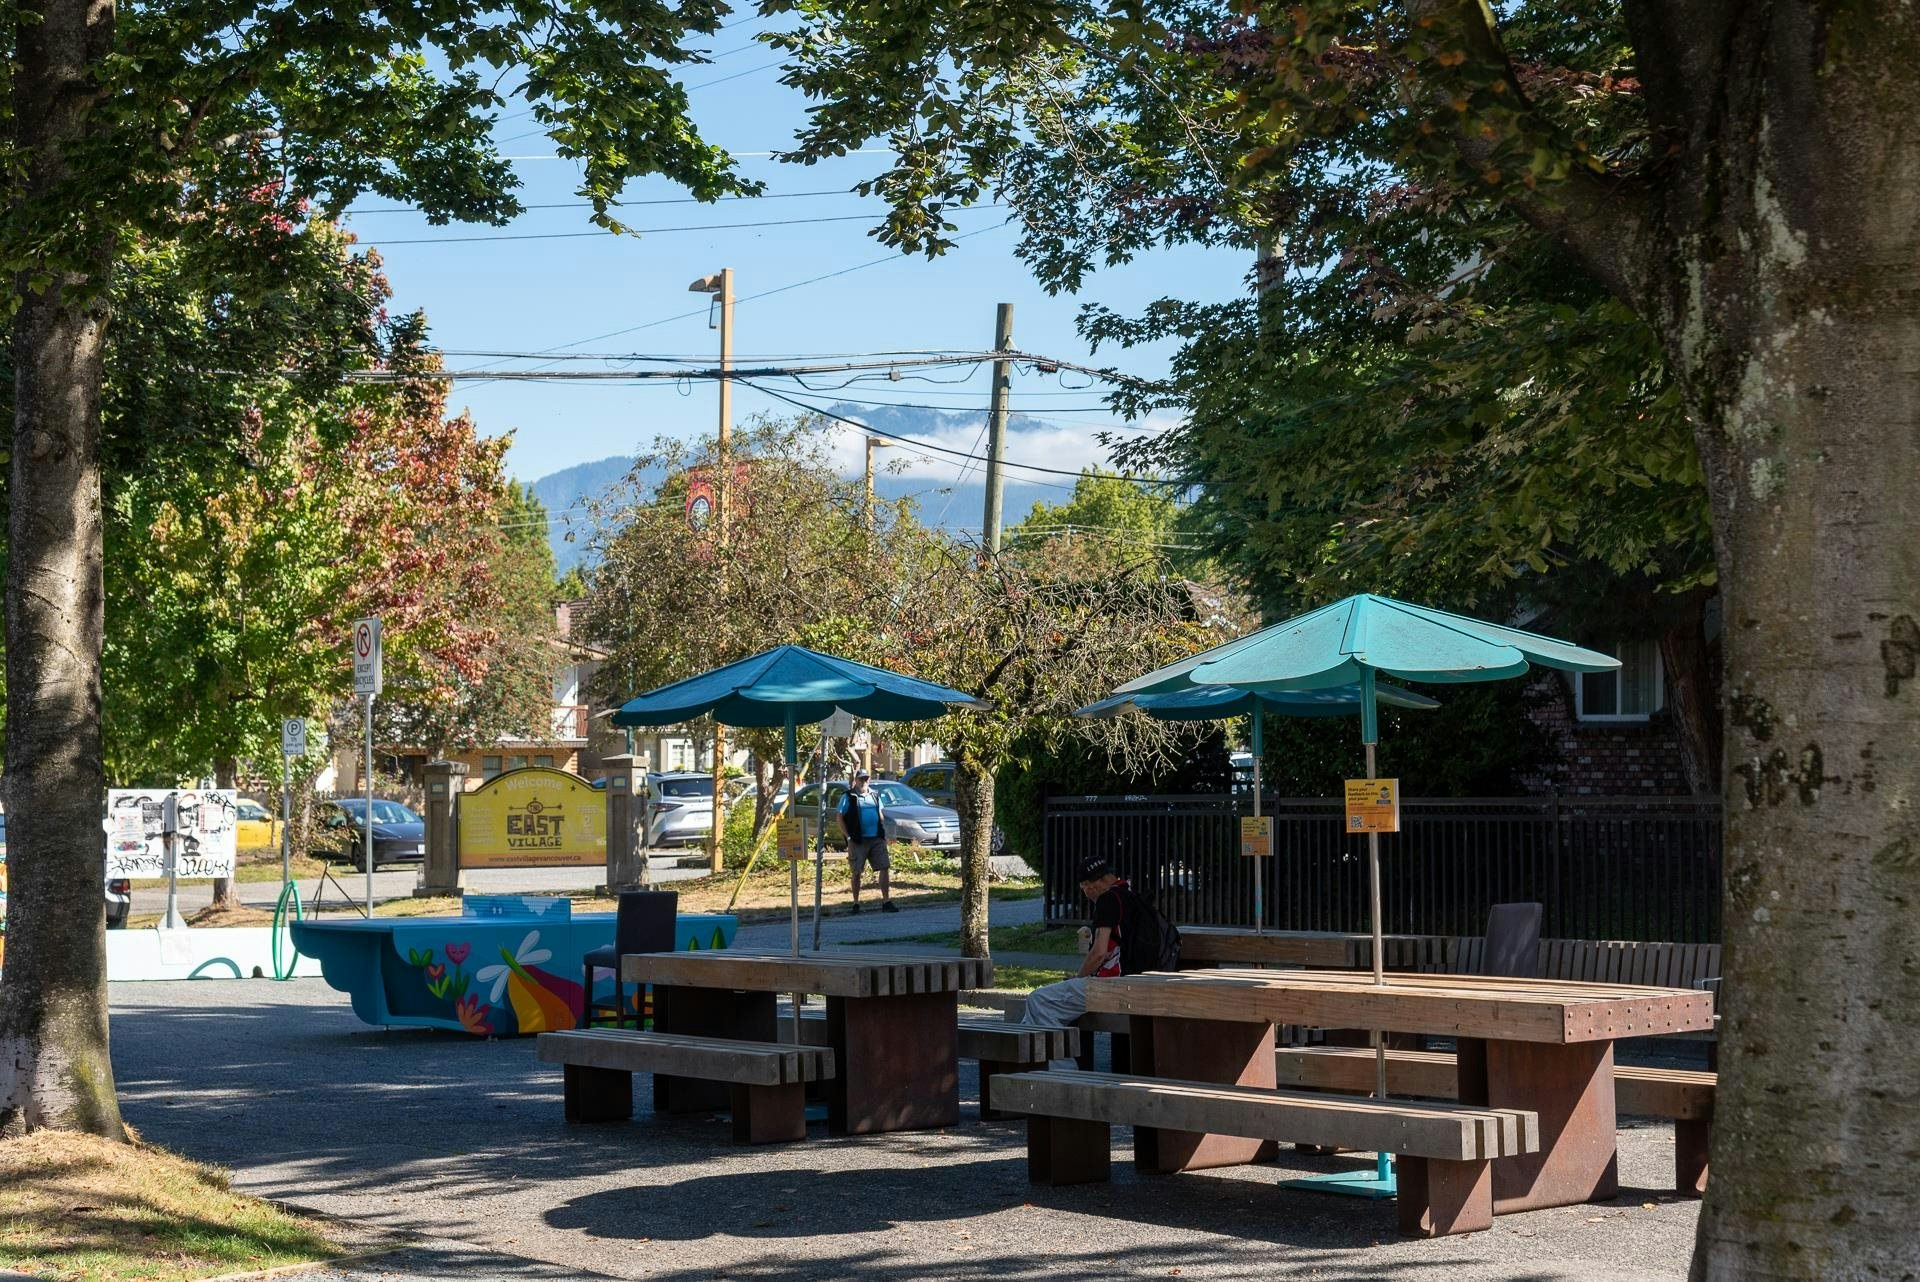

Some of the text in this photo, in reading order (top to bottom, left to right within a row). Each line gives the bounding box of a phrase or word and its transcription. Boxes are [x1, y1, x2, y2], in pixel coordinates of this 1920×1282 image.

[357, 663, 372, 673] EXCEPT
[355, 675, 374, 686] BICYCLES
[505, 777, 563, 791] Welcome
[507, 814, 565, 836] EAST
[507, 836, 562, 848] VILLAGE
[488, 855, 582, 863] www.eastvillagevancouver.ca
